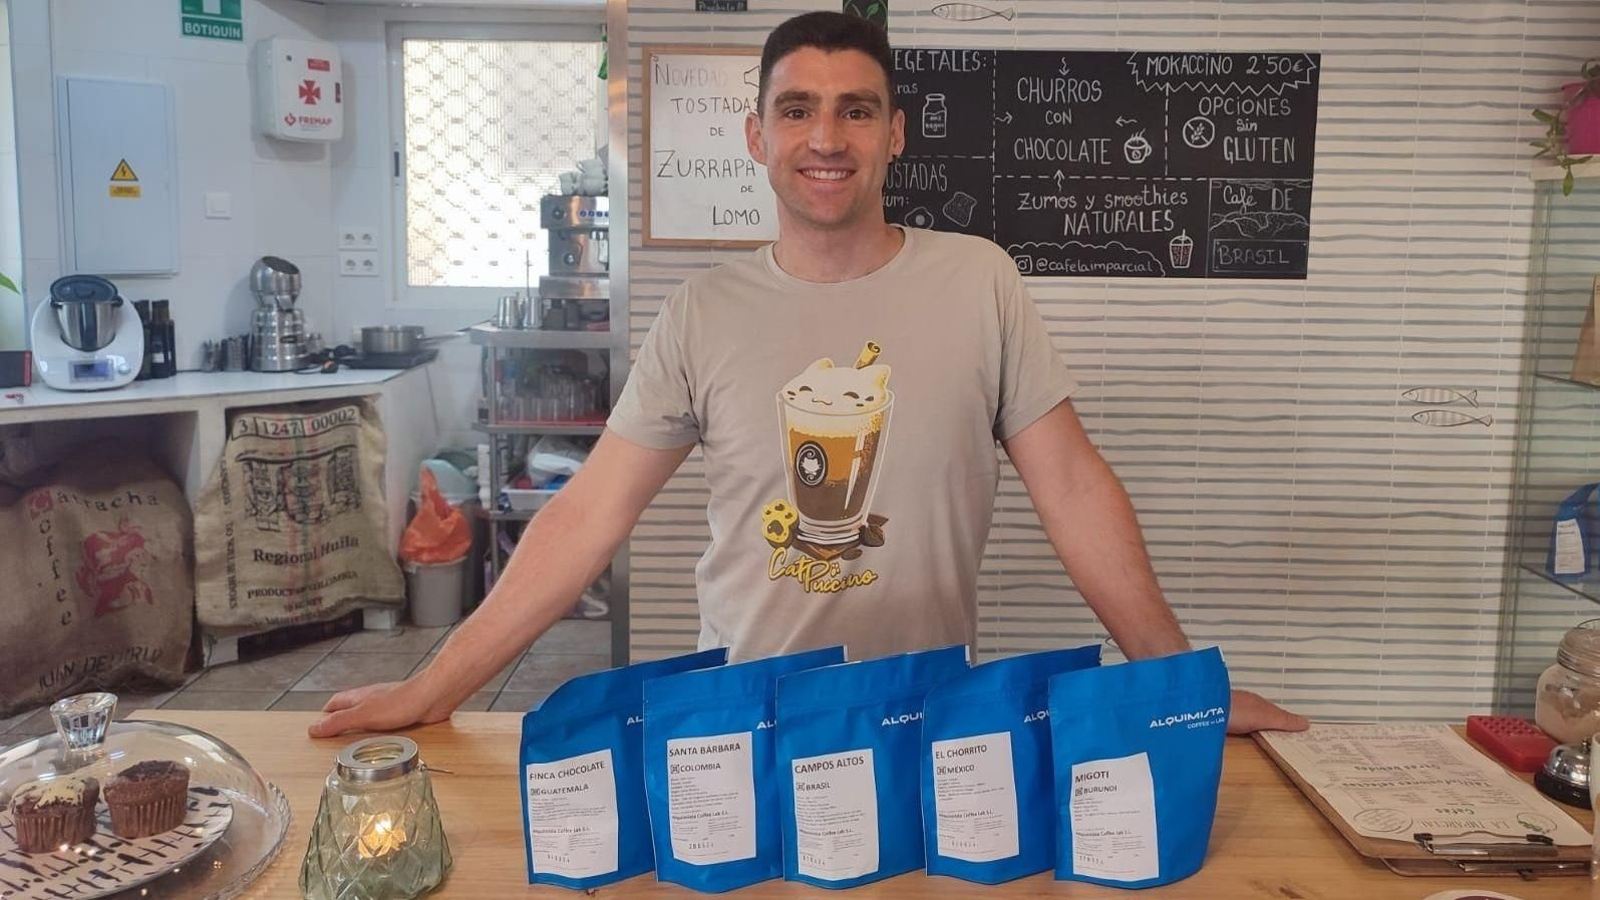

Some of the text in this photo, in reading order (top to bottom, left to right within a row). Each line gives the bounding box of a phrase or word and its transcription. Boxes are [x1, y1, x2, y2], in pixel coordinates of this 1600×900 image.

[894, 50, 987, 72] EGETALES:
[1146, 53, 1304, 76] MOKACCINO 2'50€
[897, 83, 918, 94] ras
[1017, 76, 1102, 104] CHURROS
[1199, 97, 1292, 116] OPCIONES
[299, 116, 332, 126] FREMAP
[1045, 108, 1072, 125] CON
[1237, 118, 1258, 132] sin
[709, 127, 725, 137] DE
[1014, 137, 1112, 164] CHOCOLATE
[1223, 136, 1296, 164] GLUTEN
[654, 150, 756, 178] ZURRAPA
[886, 163, 947, 191] OSTADAS
[740, 185, 754, 193] DE
[1018, 184, 1188, 210] Zumos y smoothies
[1223, 185, 1293, 215] Café DE
[713, 205, 760, 225] LOMO
[1064, 209, 1175, 236] NATURALES
[1219, 245, 1290, 265] BRASIL
[1036, 258, 1153, 273] @cafelaimparcial
[240, 408, 355, 435] 3 1247 00002
[253, 536, 359, 565] Regional Huila
[247, 588, 295, 599] PRODUCT
[627, 716, 643, 725] AL
[1149, 707, 1225, 728] ALQUIMISTA
[1187, 721, 1209, 729] COFFEE
[669, 747, 698, 757] SANTA
[936, 744, 988, 759] EL CHORRITO
[529, 761, 605, 781] FINCA CHOCOLATE
[680, 763, 721, 773] COLOMBIA
[795, 756, 865, 774] CAMPOS ALTOS
[1075, 771, 1109, 783] MIGOTI
[541, 783, 589, 796] GUATEMALA
[806, 782, 831, 791] BRASIL
[1083, 785, 1118, 795] BURUNDI
